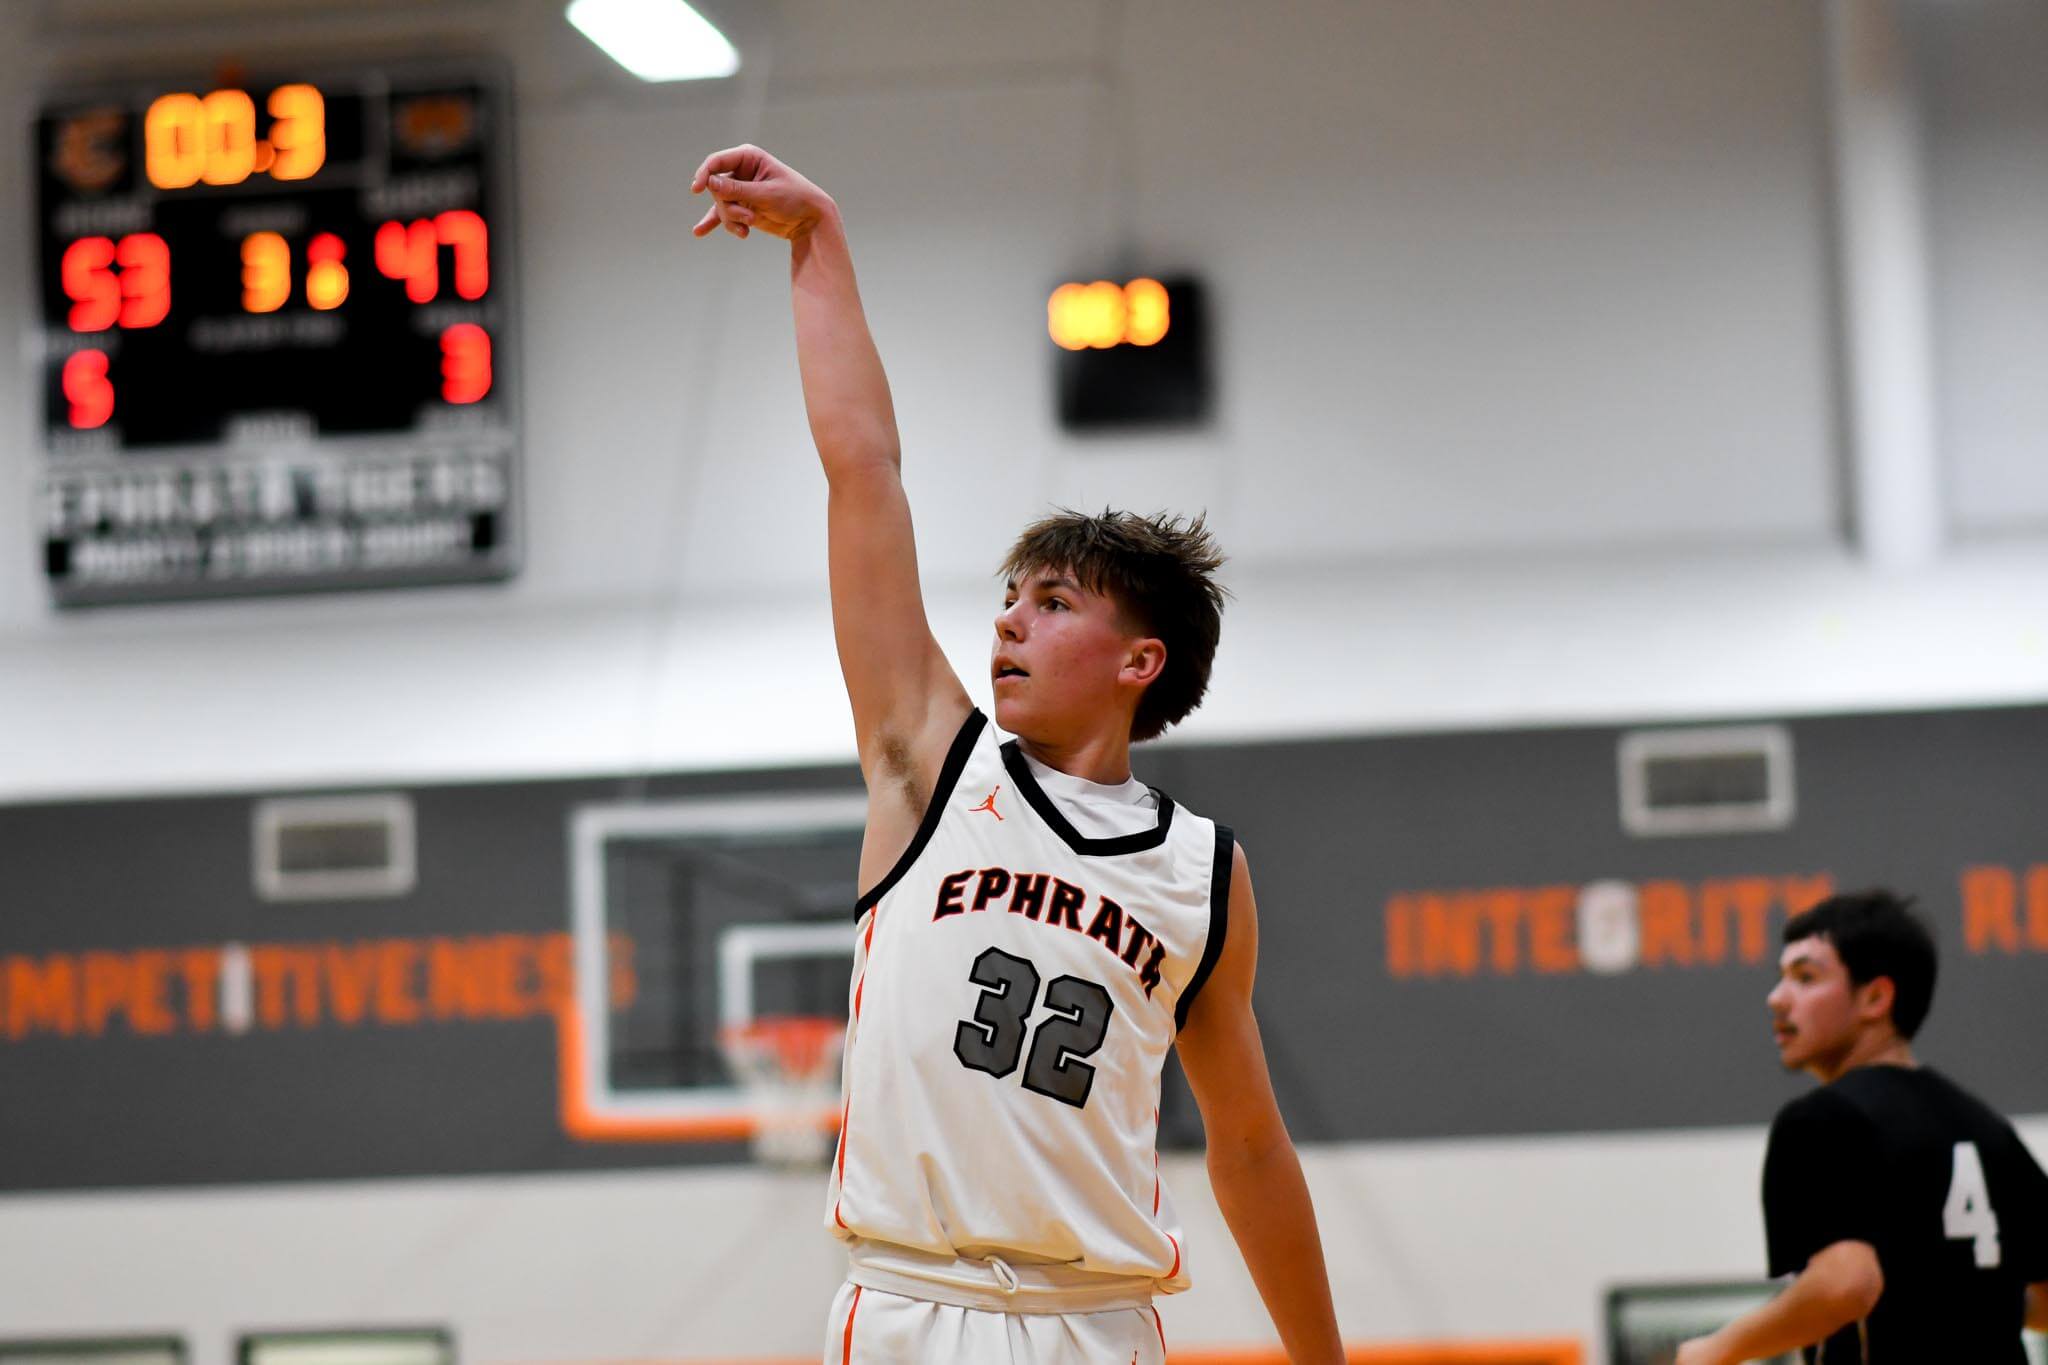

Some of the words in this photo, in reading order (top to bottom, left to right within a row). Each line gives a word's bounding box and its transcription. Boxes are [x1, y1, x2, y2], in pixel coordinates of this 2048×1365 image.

[144, 84, 326, 189] 00.3
[62, 232, 171, 333] 53
[241, 231, 292, 313] 3
[375, 210, 489, 304] 47
[440, 322, 493, 405] 3
[932, 866, 1167, 1003] EPHRATA
[952, 945, 1115, 1110] 32
[1942, 1140, 2000, 1269] 4
